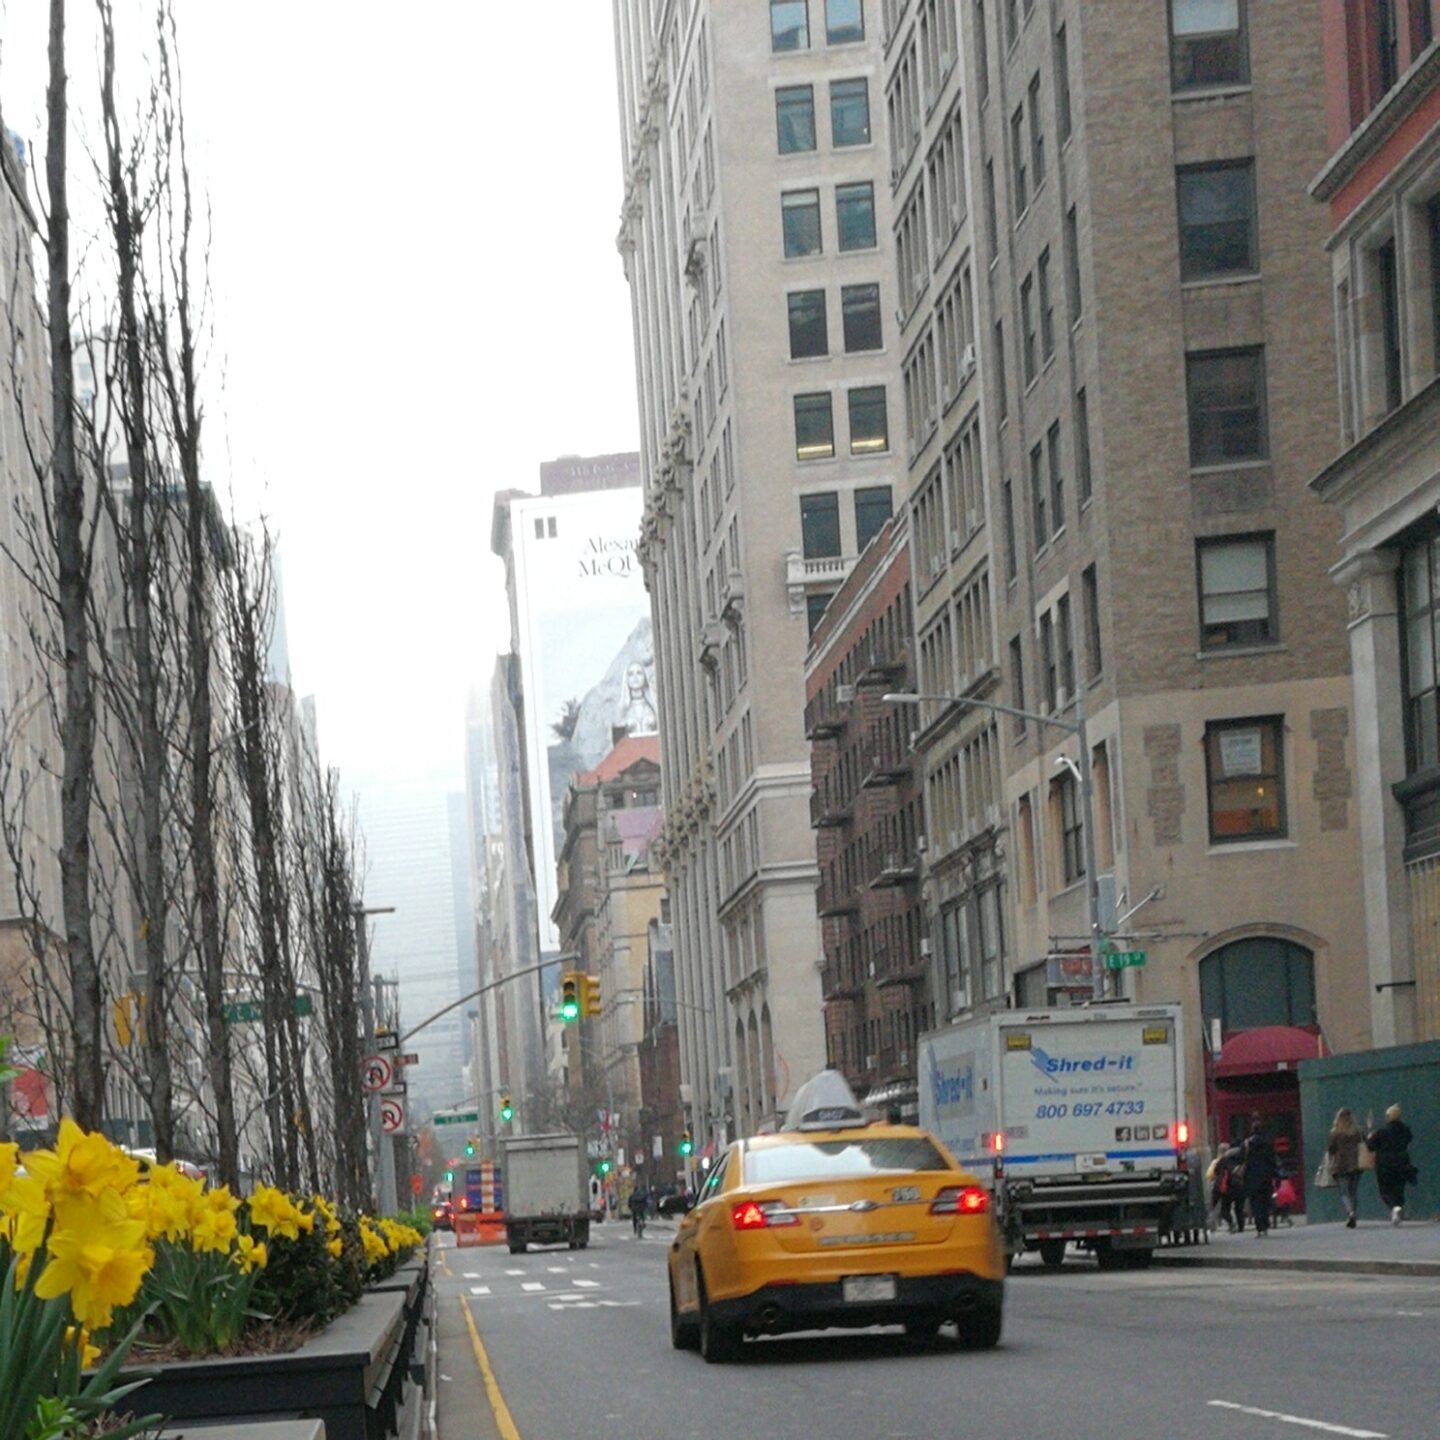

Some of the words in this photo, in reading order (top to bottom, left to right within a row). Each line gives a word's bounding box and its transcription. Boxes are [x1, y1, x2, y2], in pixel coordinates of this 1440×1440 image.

[1109, 954, 1115, 967] E
[1046, 1056, 1133, 1072] Shred-it
[1034, 1086, 1068, 1096] Making
[1070, 1086, 1089, 1094] sure
[1091, 1085, 1104, 1093] it's
[1036, 1104, 1068, 1119] 800
[1073, 1102, 1103, 1116] 697
[1105, 1100, 1145, 1115] 4733
